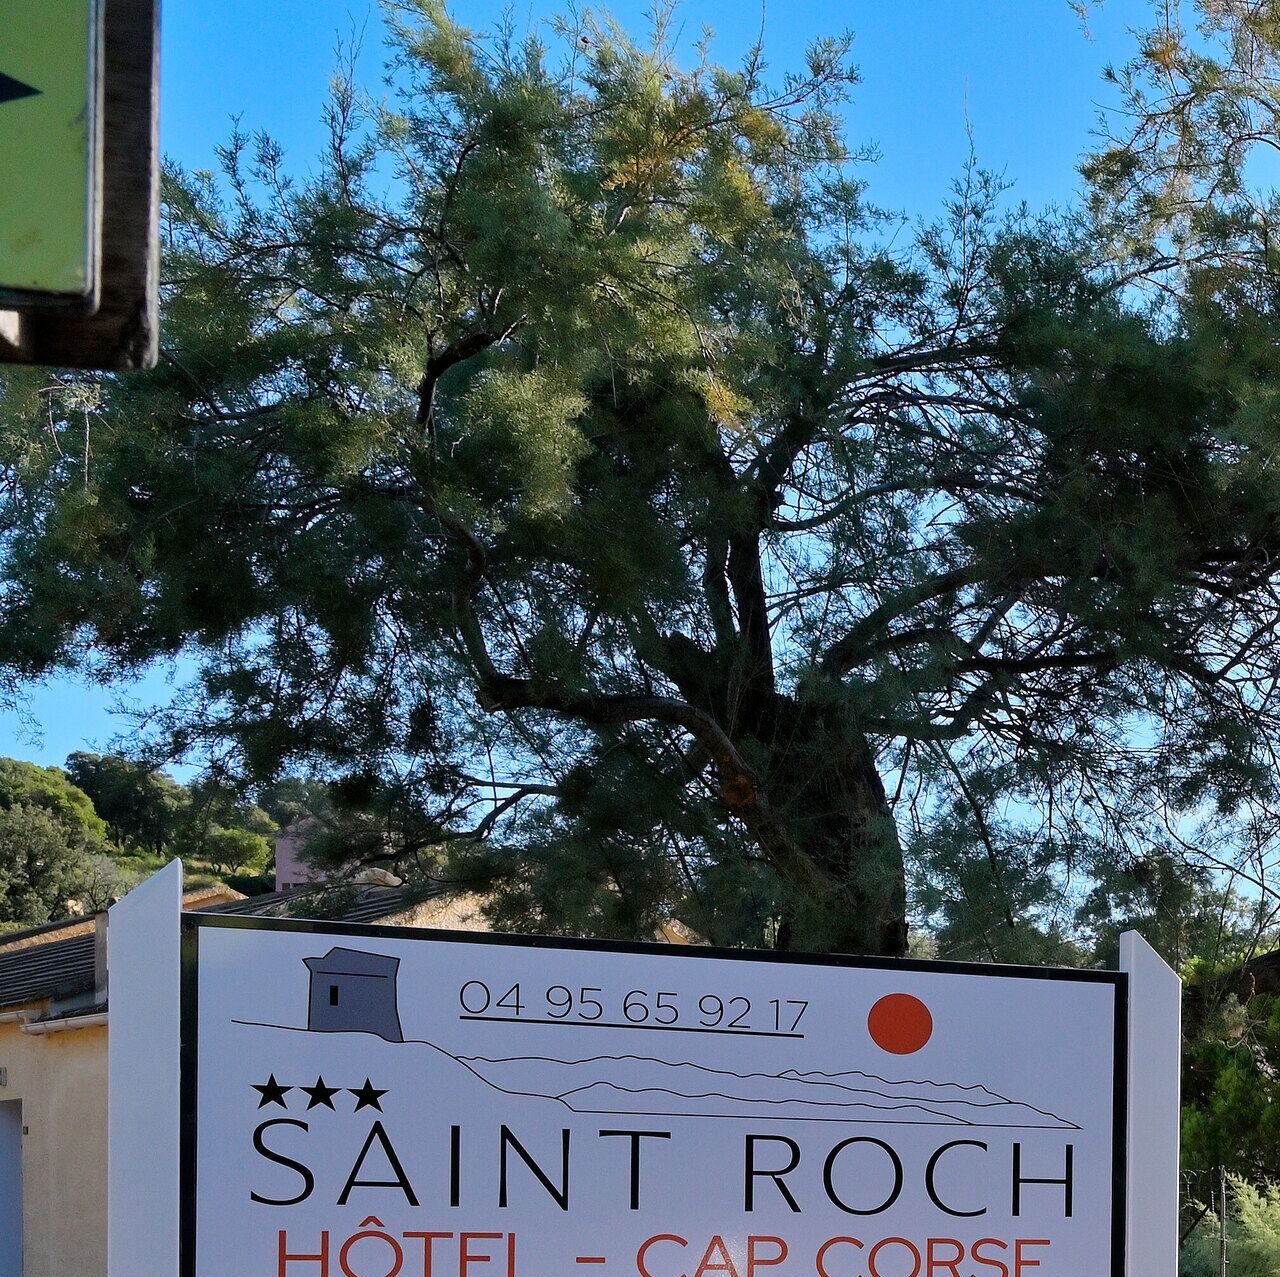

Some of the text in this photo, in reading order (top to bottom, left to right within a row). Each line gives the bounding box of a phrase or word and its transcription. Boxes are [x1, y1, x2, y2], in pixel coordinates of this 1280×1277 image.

[459, 980, 809, 1032] 04 95 65 92 17
[251, 1119, 1074, 1217] SAINT ROCH
